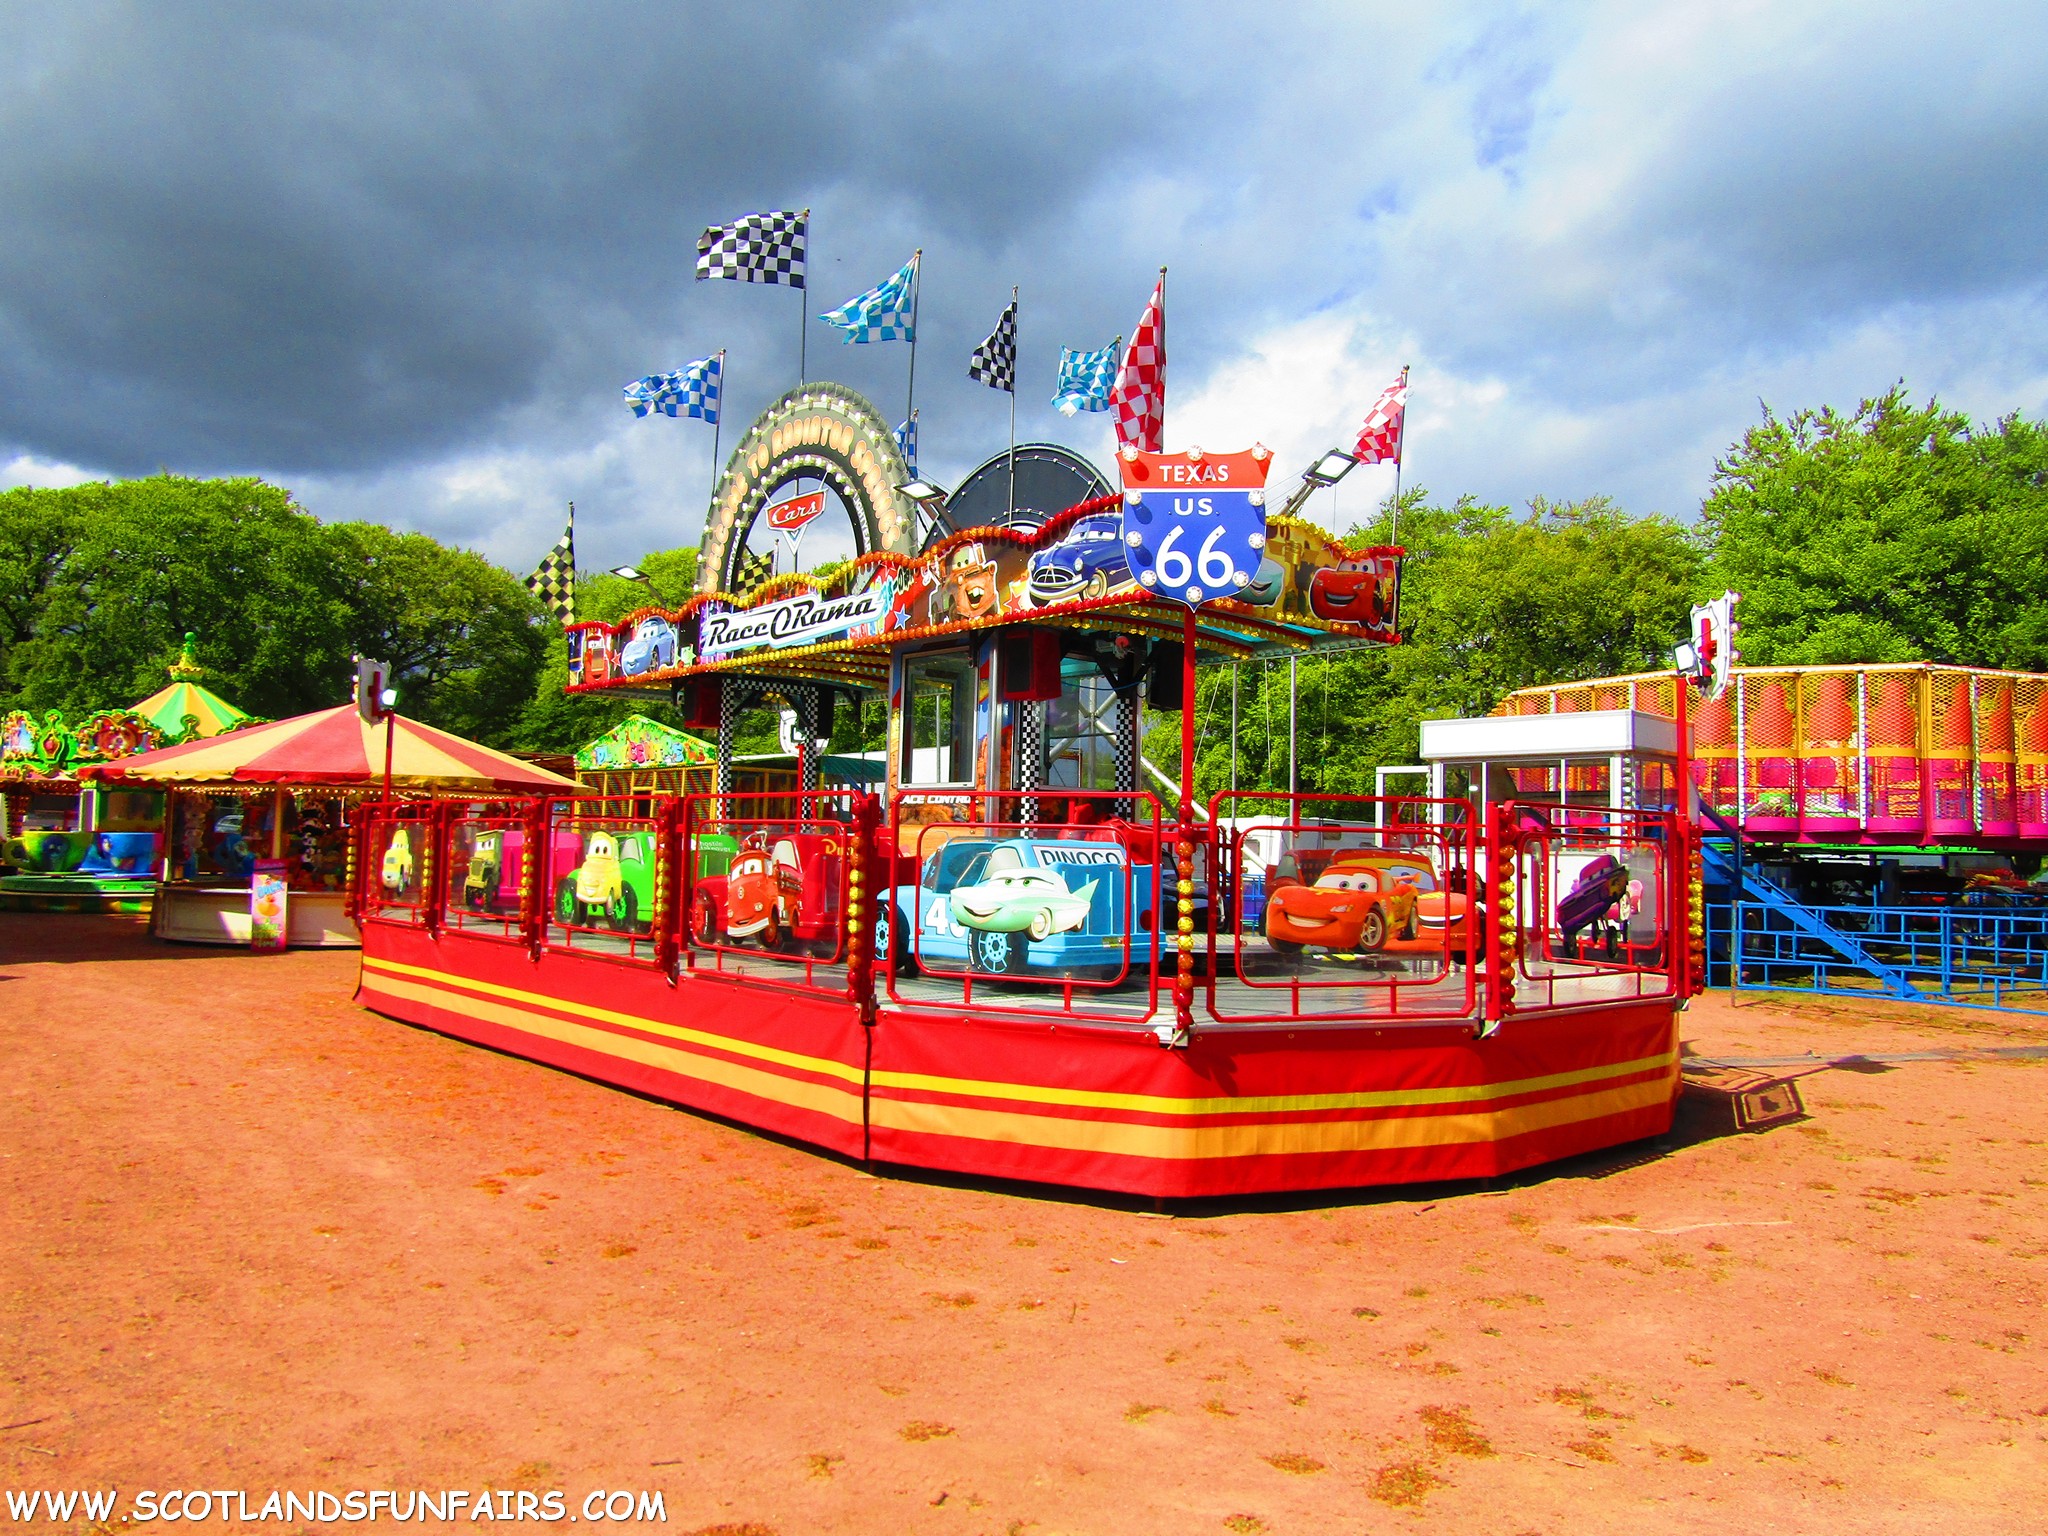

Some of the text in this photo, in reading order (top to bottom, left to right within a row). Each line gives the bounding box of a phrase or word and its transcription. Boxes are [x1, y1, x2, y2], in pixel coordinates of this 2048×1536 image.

[747, 443, 770, 479] TO
[772, 415, 854, 458] RADIATOR
[1159, 464, 1229, 483] TEXAS
[771, 500, 821, 525] Cars
[1174, 498, 1213, 516] US
[852, 492, 872, 554] LIGHTYEAR
[725, 527, 743, 587] LIGHTYEAR
[1155, 524, 1235, 588] 66
[899, 794, 979, 804] ACE CONTRO
[1040, 849, 1121, 866] DINOCO
